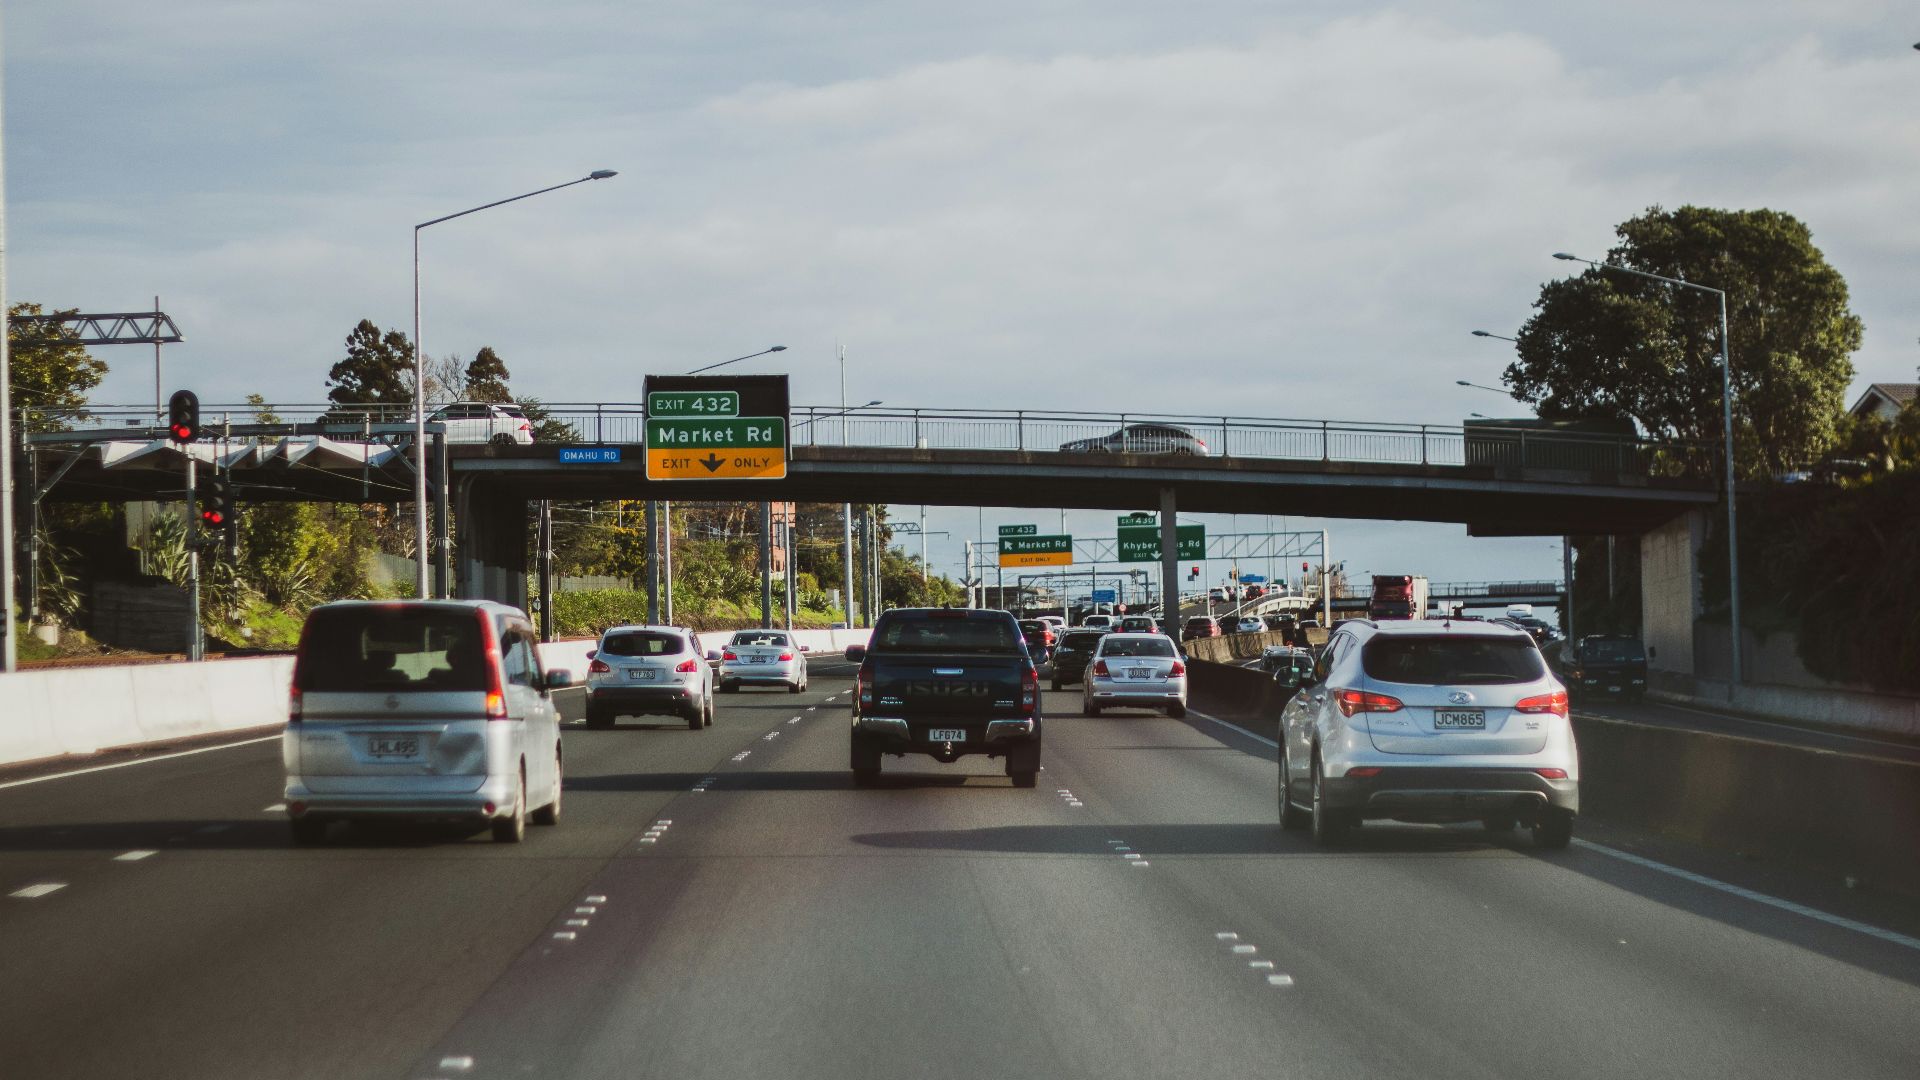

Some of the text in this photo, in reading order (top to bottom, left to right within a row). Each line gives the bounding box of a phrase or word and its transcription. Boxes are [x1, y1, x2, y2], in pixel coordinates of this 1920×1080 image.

[656, 397, 731, 412] EXIT 432
[659, 426, 772, 443] Market Rd
[564, 451, 617, 460] OMAHU RD
[662, 457, 770, 469] EXIT ONLY
[1018, 540, 1067, 549] Market Rd
[1123, 541, 1158, 551] Khyber
[906, 681, 989, 697] ISUZU
[1437, 713, 1484, 726] JCM865
[933, 730, 962, 741] LFG74
